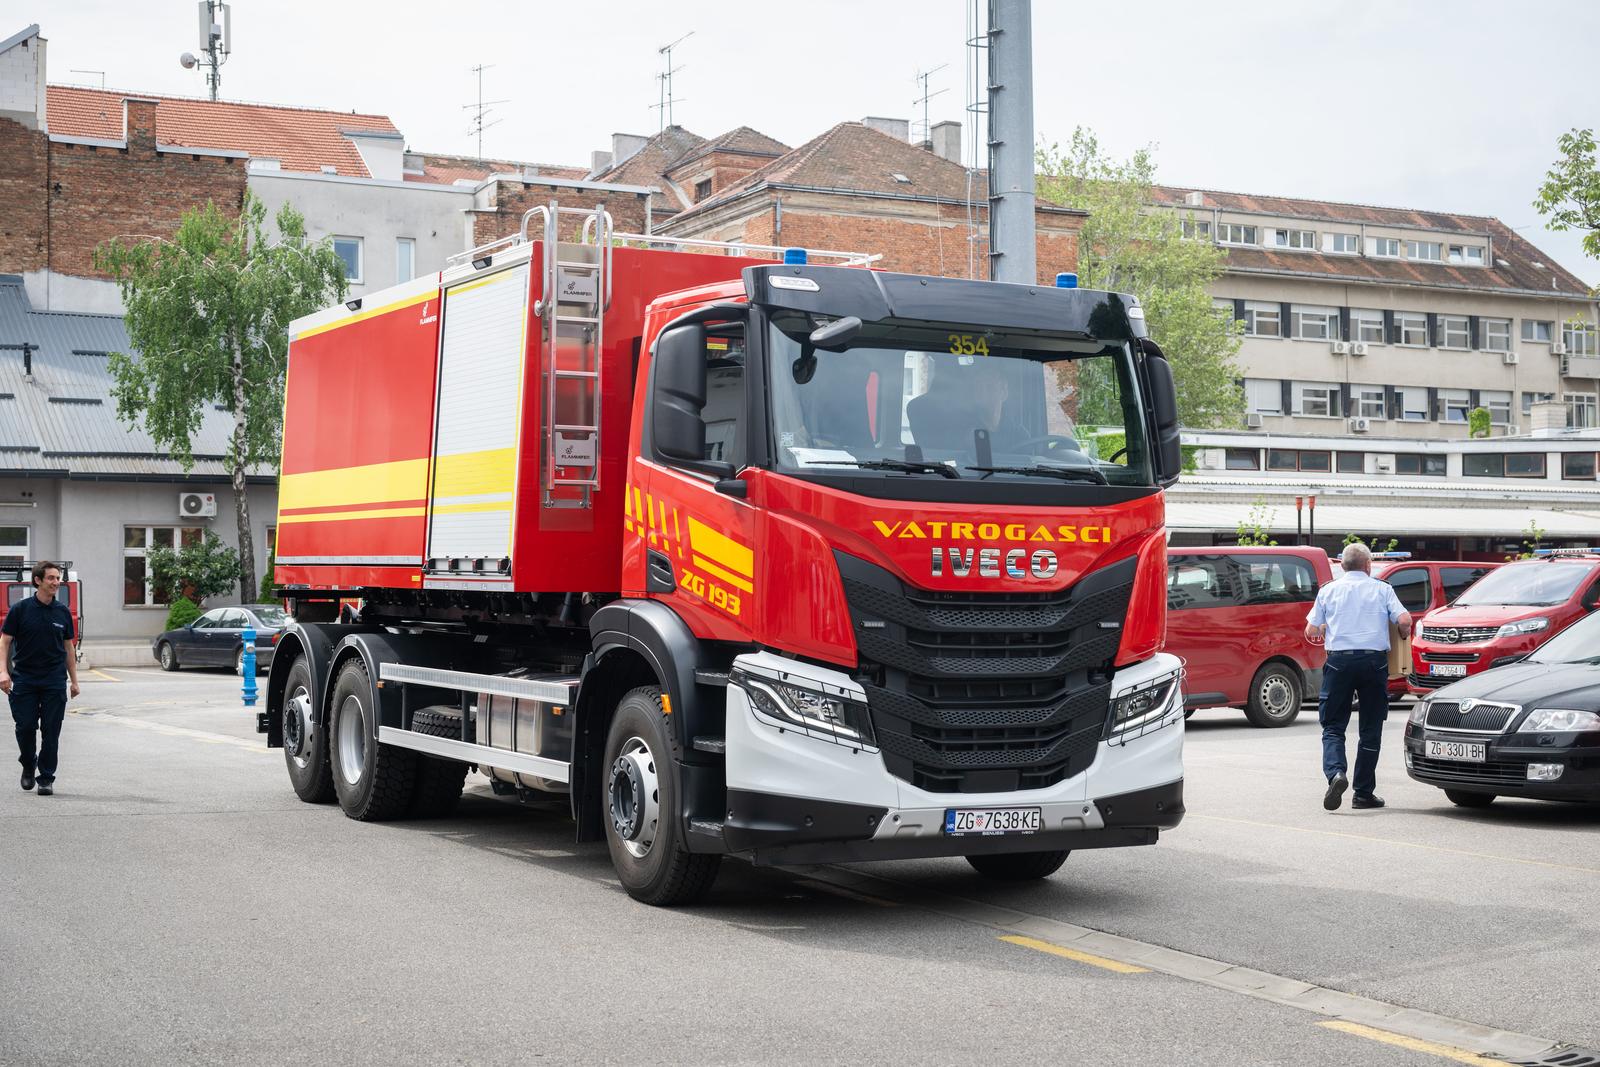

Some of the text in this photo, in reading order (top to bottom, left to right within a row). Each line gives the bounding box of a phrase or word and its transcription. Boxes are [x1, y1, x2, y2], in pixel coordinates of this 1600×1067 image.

[948, 334, 990, 357] 354
[872, 520, 1111, 543] VATROGASCI
[931, 547, 1058, 579] IVECO
[680, 567, 741, 616] ZG 193
[1431, 741, 1442, 755] ZG
[956, 812, 975, 830] ZG
